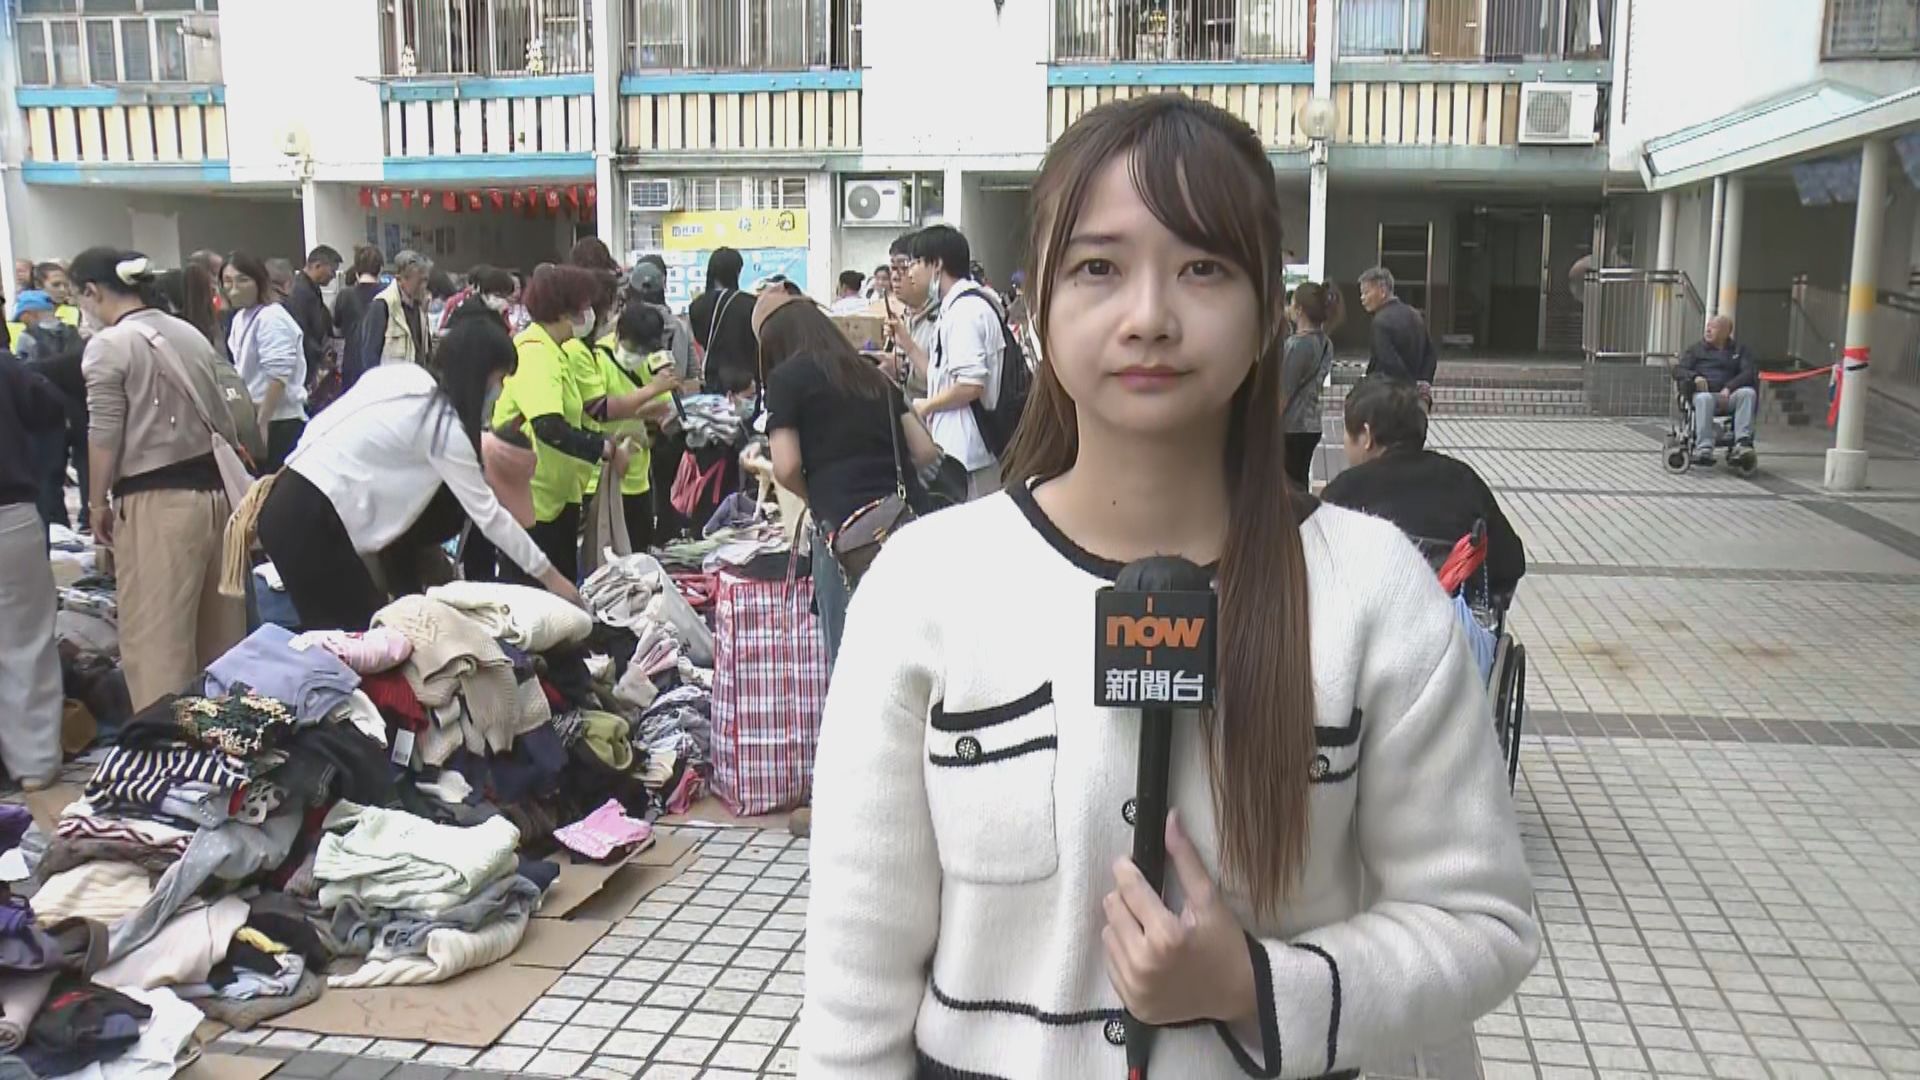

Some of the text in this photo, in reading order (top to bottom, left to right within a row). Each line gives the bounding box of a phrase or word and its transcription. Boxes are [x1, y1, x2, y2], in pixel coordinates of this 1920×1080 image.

[1106, 616, 1205, 648] now
[1105, 668, 1204, 702] 新聞台
